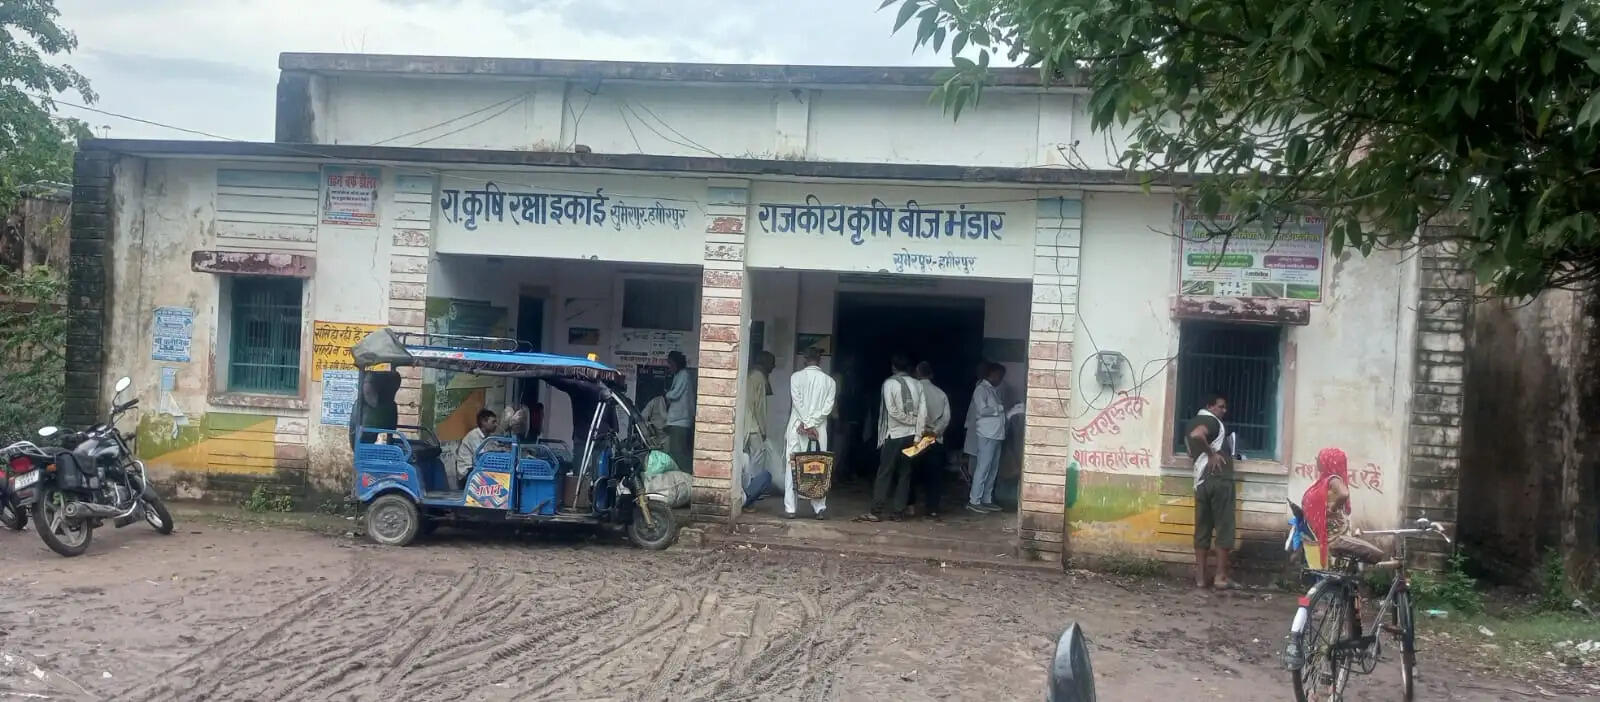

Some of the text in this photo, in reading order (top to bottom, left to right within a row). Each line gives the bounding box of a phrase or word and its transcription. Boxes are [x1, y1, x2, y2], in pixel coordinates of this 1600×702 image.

[758, 194, 1006, 245] राजकीय कृषि बीज भंडार
